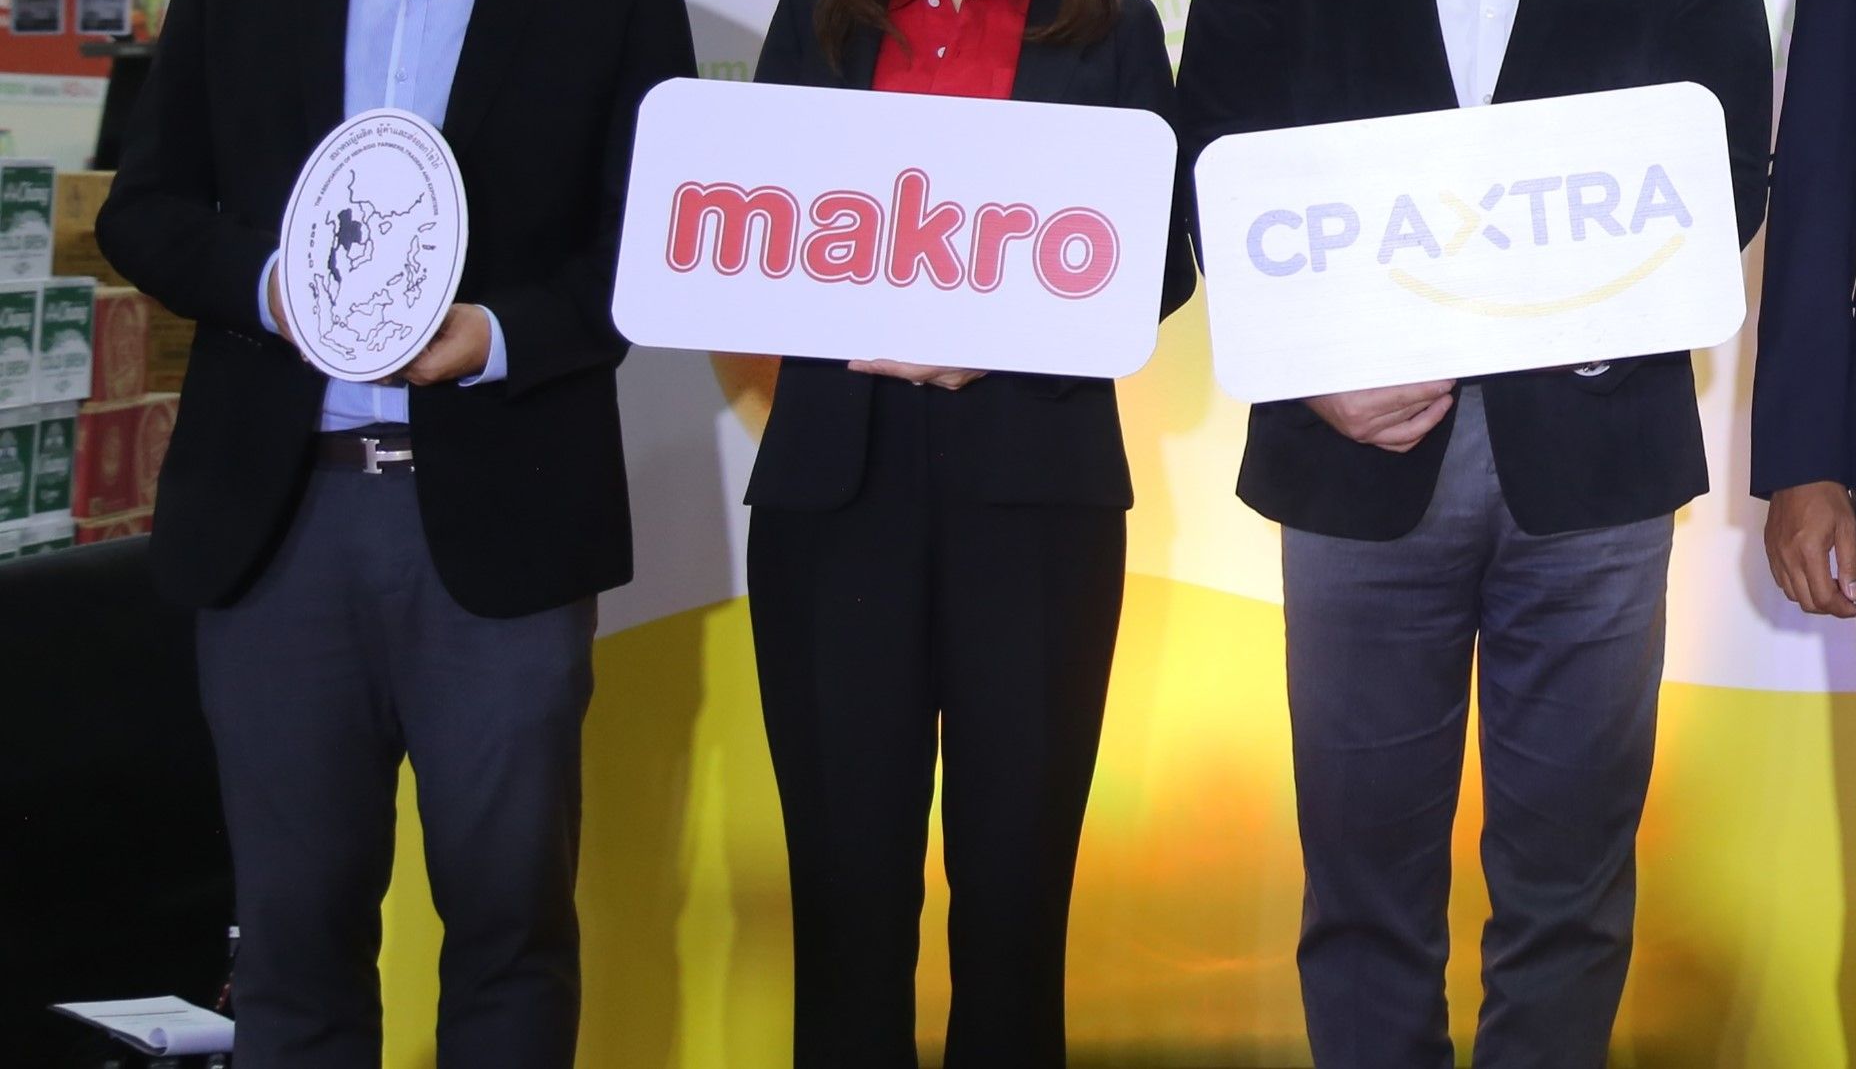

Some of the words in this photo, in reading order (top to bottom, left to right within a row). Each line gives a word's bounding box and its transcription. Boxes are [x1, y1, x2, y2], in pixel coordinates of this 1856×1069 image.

[664, 167, 1121, 300] makro
[1246, 201, 1361, 278] CP
[1375, 163, 1694, 265] AXTRA
